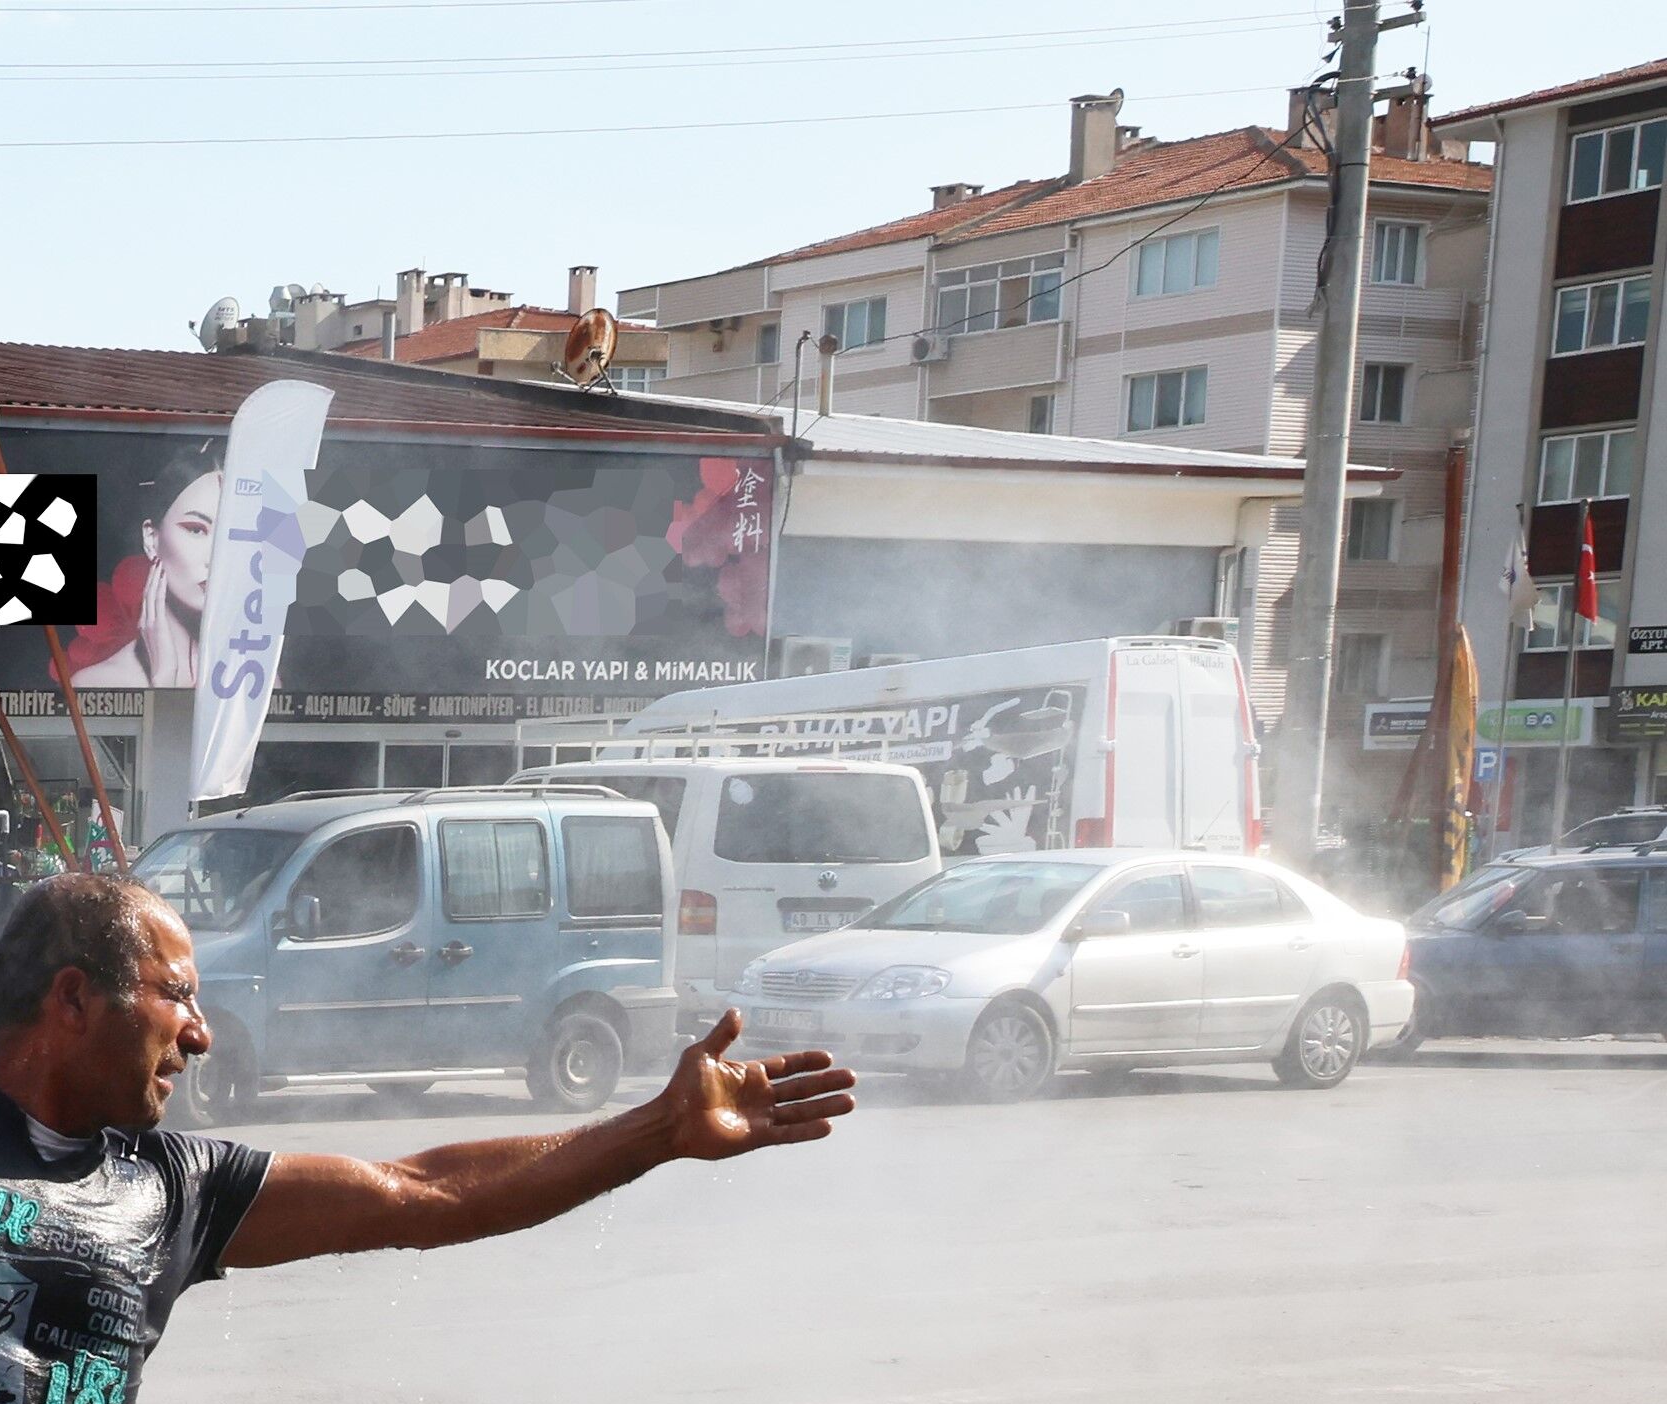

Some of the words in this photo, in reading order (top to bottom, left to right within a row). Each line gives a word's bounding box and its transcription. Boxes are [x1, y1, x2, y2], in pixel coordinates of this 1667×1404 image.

[485, 660, 575, 683] KOÇLAR
[582, 661, 629, 681] YAPI
[634, 662, 649, 681] &
[383, 693, 417, 717] SÖVE
